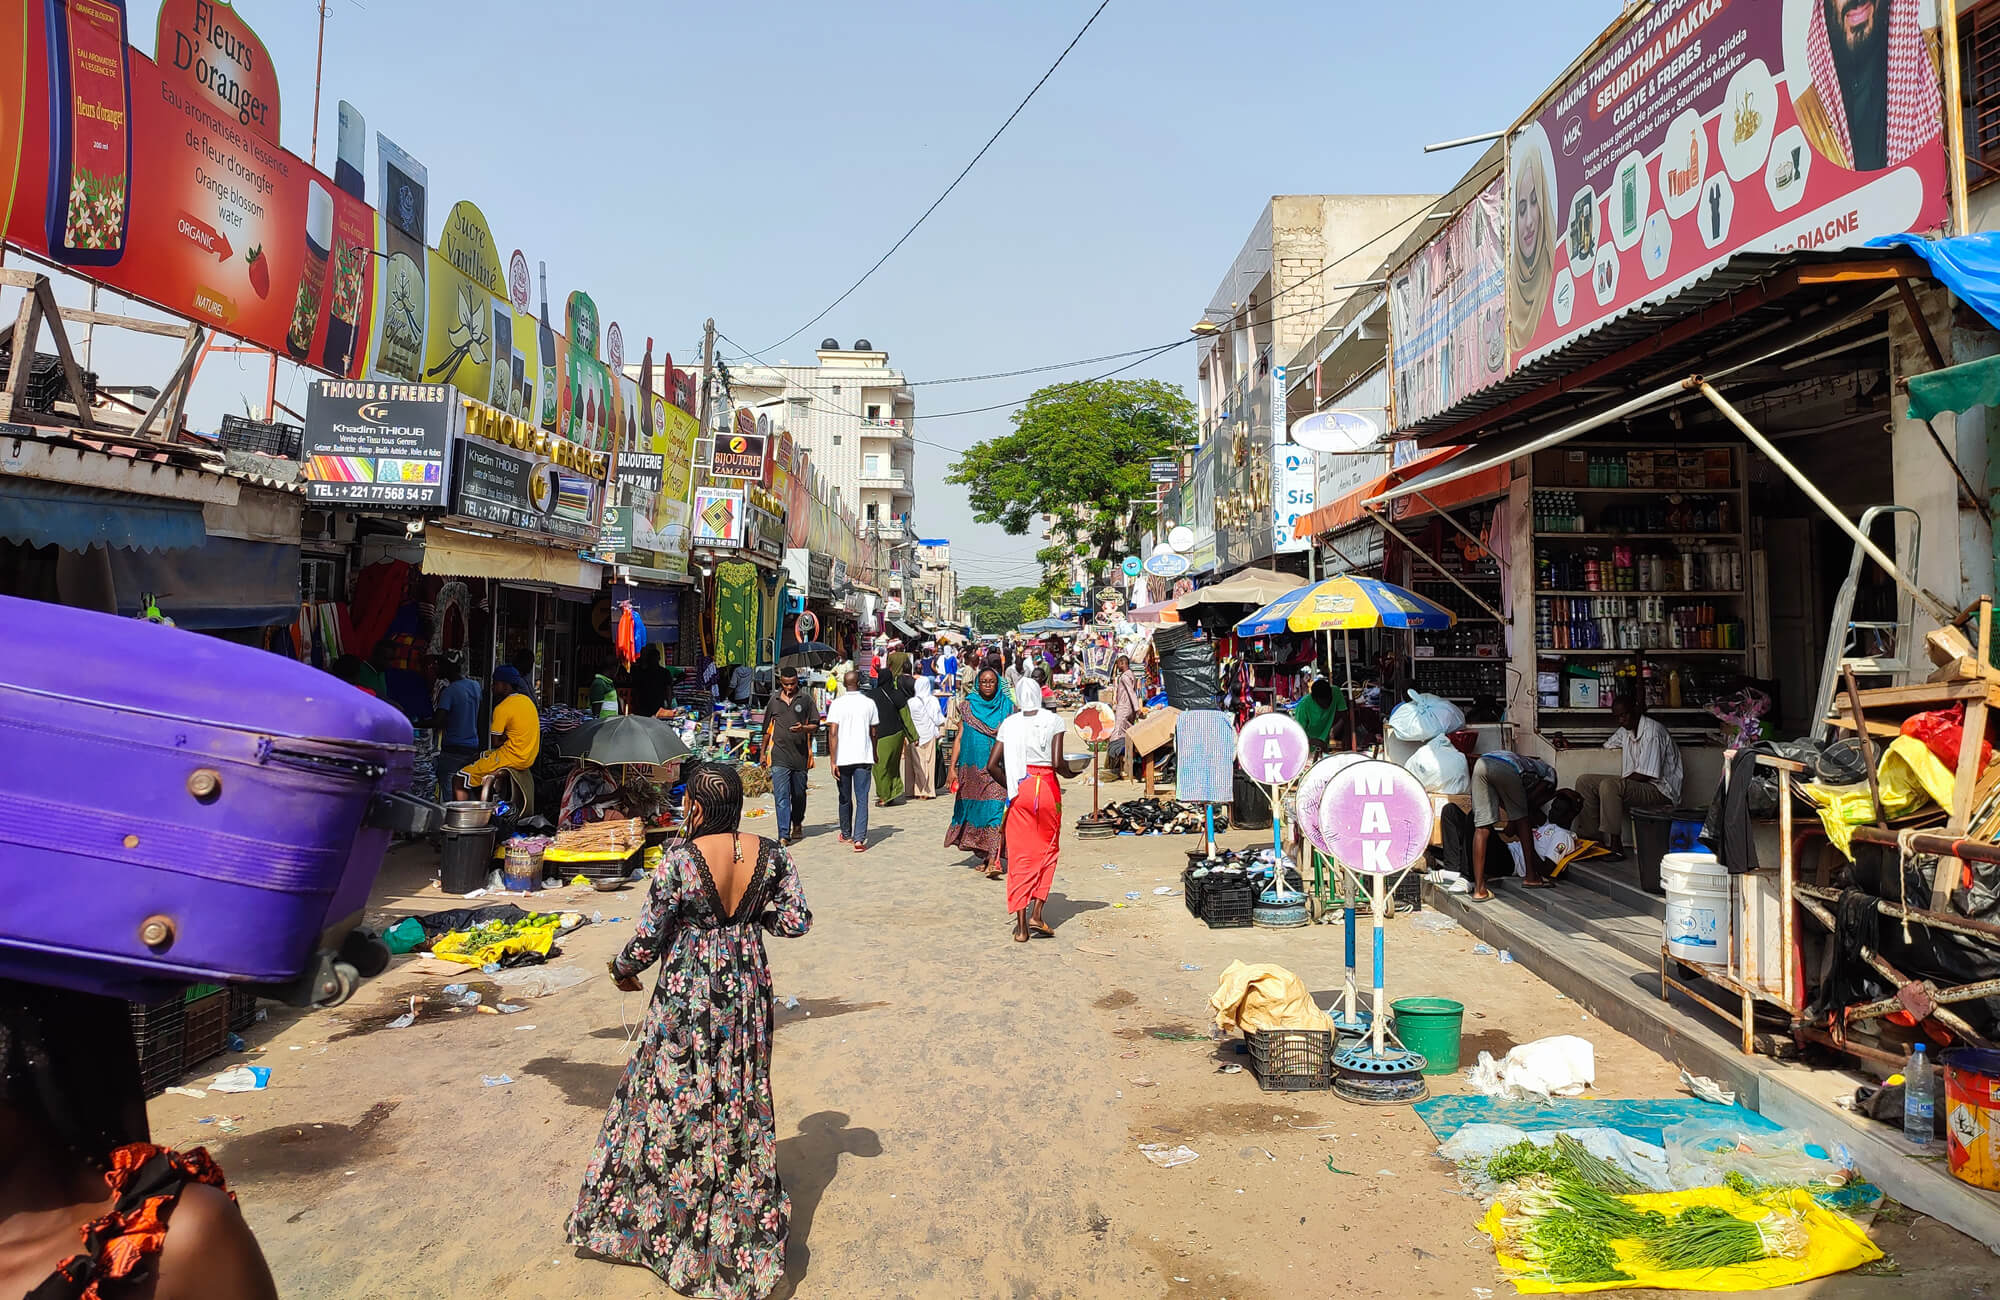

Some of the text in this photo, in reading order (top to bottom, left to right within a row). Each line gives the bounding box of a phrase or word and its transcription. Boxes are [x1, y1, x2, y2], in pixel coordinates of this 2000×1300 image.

[193, 0, 253, 72] Fleurs
[1556, 79, 1588, 120] MAKINE
[1588, 24, 1645, 90] THIOURAYE
[1596, 40, 1664, 113] SEURITHIA
[1613, 40, 1702, 126] GUEYE & FRERES
[1583, 147, 1600, 166] Vente
[1600, 136, 1615, 153] tous
[1647, 85, 1678, 119] produits
[1678, 60, 1706, 91] venant
[1706, 53, 1718, 69] de
[1718, 29, 1747, 60] Djidda
[161, 80, 182, 109] Eau
[185, 100, 241, 148] aromatisée
[250, 139, 289, 178] l'essence
[1633, 122, 1654, 146] Arabe
[185, 129, 200, 151] de
[201, 136, 225, 166] fleur
[195, 167, 264, 220] Orange blossom
[218, 205, 243, 228] water
[454, 202, 486, 249] Sucre
[177, 219, 215, 250] ORGANIC
[1797, 210, 1859, 251] DIAGNE
[195, 294, 224, 318] NATUREL
[321, 381, 445, 403] THIOUB & FRERES
[333, 423, 425, 436] Khadim THIOUB
[462, 399, 537, 454] THIOUB
[339, 434, 357, 444] Vente
[469, 449, 520, 474] Khadim THIOUB
[617, 452, 663, 470] BIJOUTERIE
[714, 452, 762, 467] BIJOUTERIE
[714, 466, 734, 475] ZAM
[734, 468, 753, 477] ZAM
[314, 484, 334, 497] TEL
[350, 486, 369, 498] 221
[371, 486, 385, 499] 77
[384, 487, 405, 499] 568
[406, 487, 419, 500] 54
[420, 489, 434, 501] 57
[635, 475, 652, 491] ZAM
[1287, 489, 1314, 504] Sis
[464, 499, 477, 515] TEL
[502, 508, 510, 523] 77
